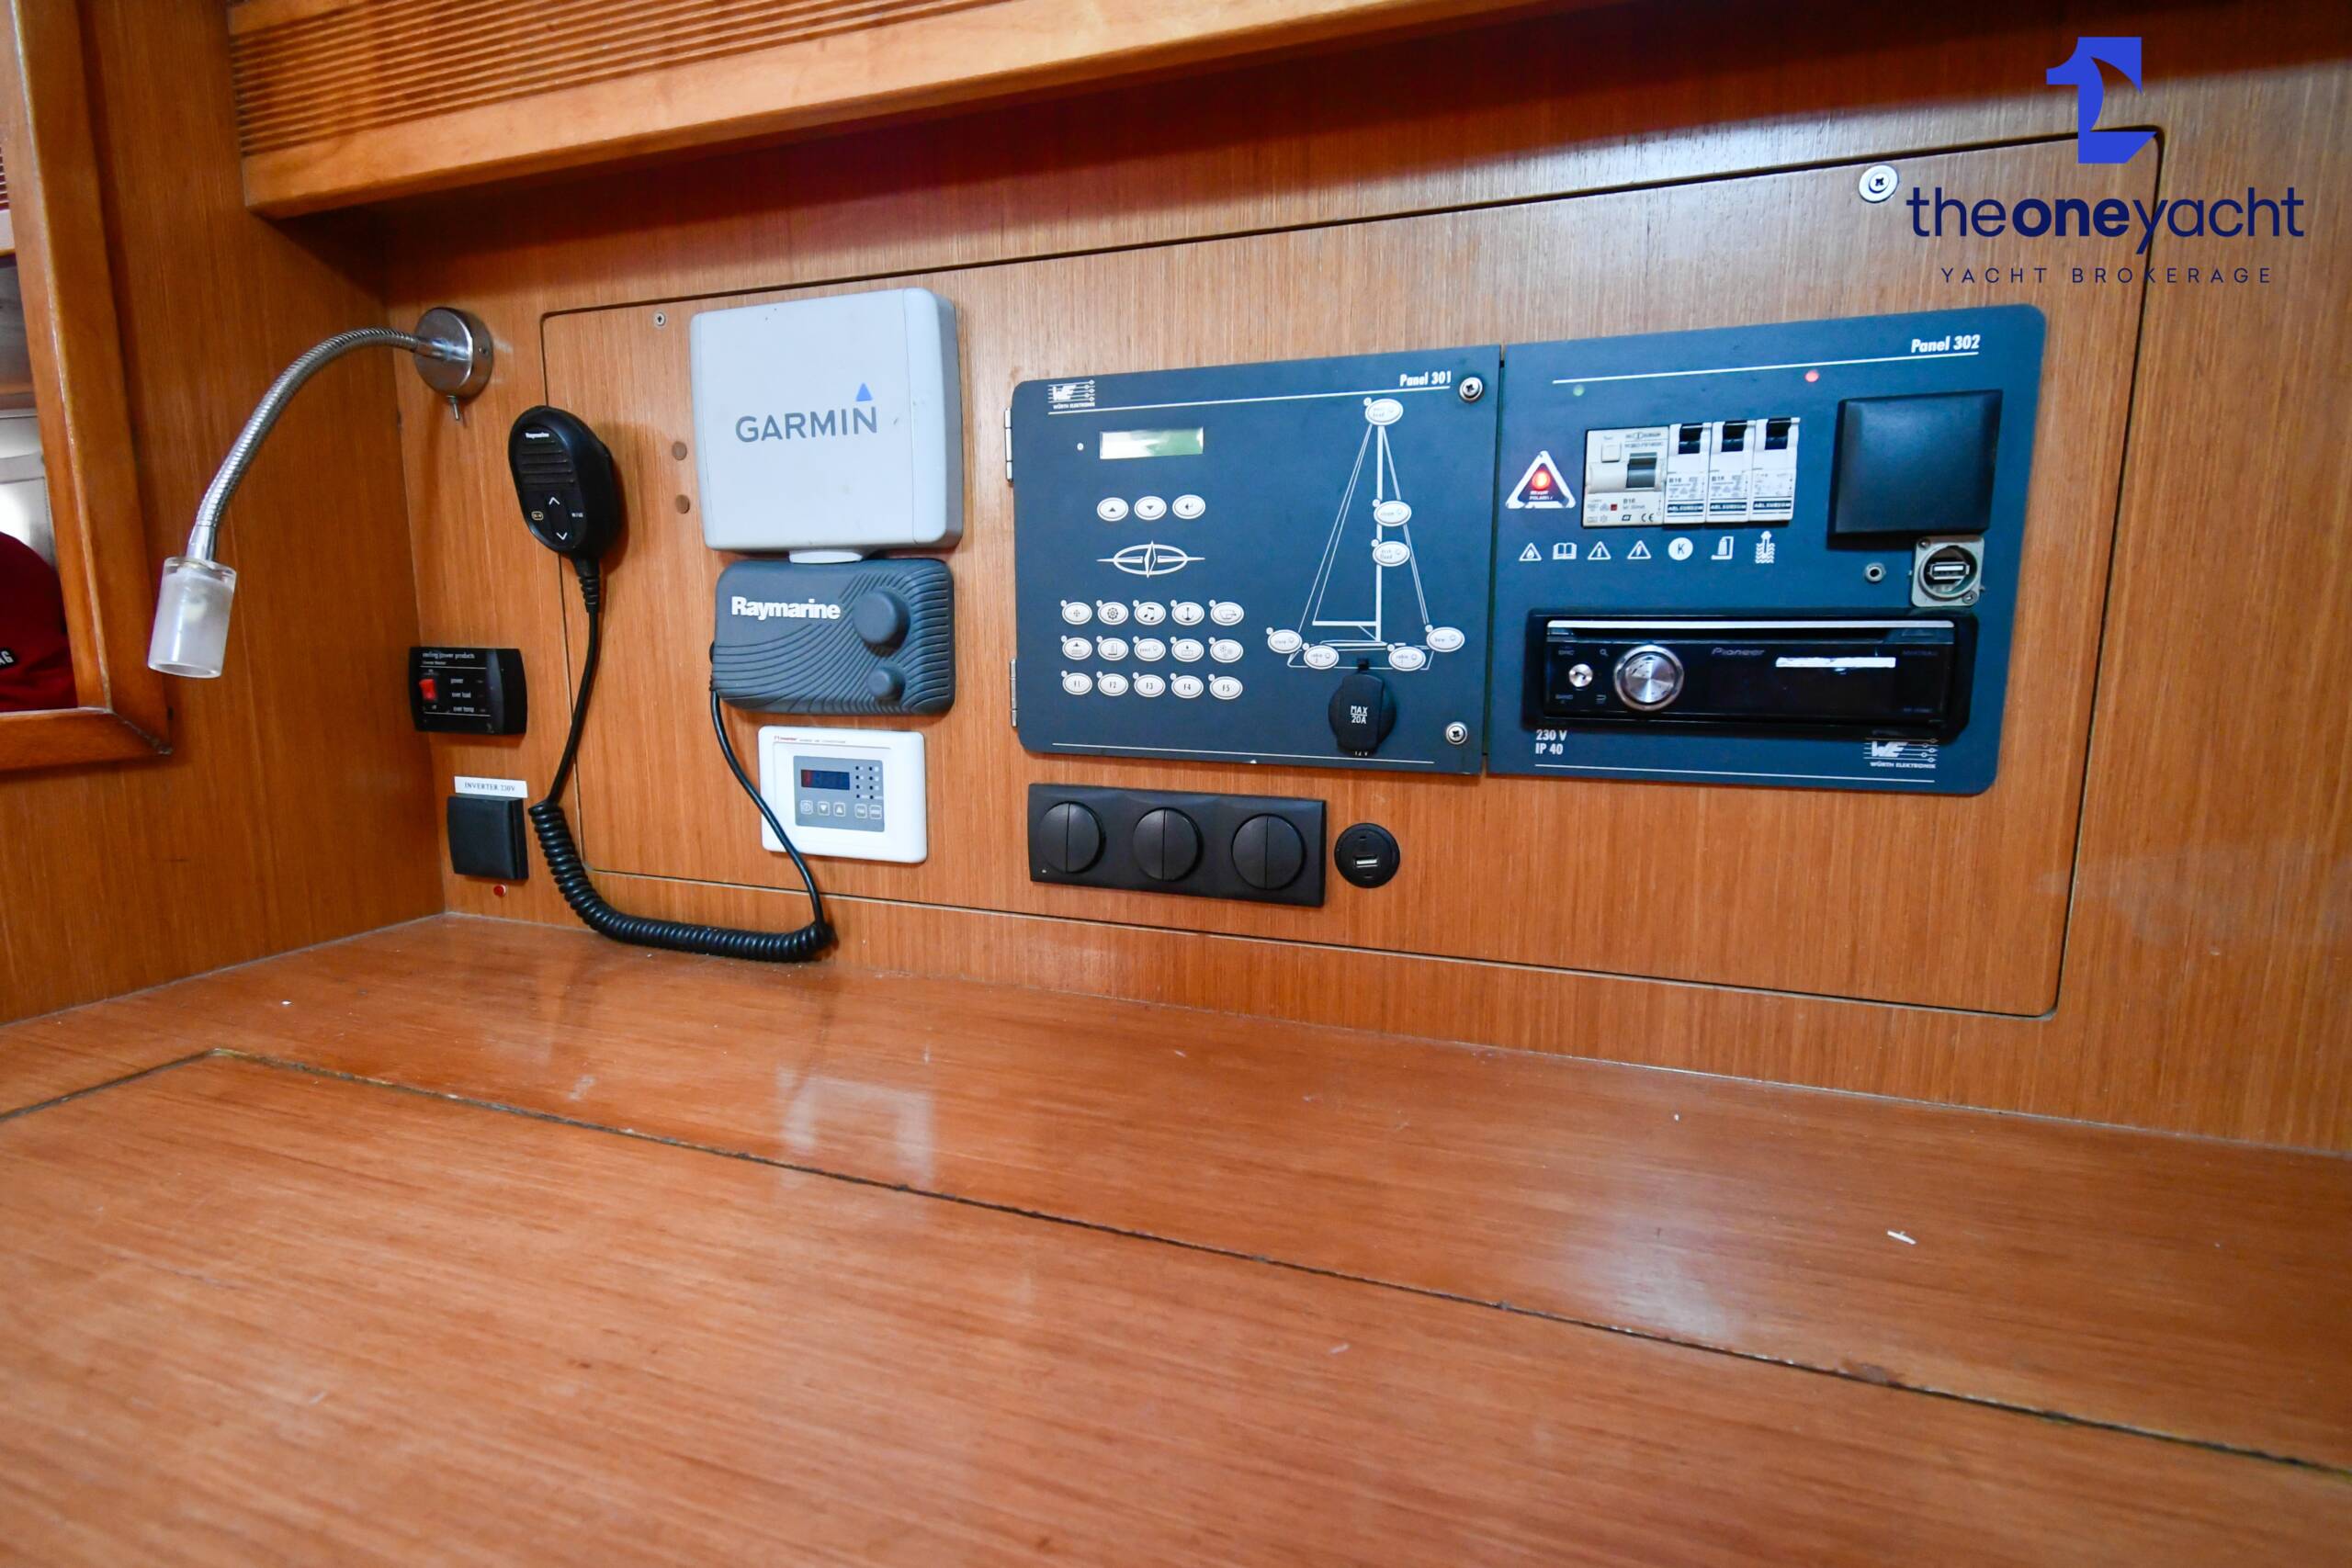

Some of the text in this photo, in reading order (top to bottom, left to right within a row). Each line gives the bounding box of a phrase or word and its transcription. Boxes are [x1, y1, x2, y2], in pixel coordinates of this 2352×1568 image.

[1911, 333, 1981, 354] Panel 302
[1399, 370, 1452, 387] Panel 301
[735, 406, 877, 443] GARMIN
[1677, 543, 1686, 555] K
[731, 596, 841, 621] Raymarine
[1712, 647, 1766, 656] Pioneer
[1351, 705, 1368, 715] MAX
[1351, 716, 1367, 724] 20A
[1535, 728, 1567, 741] 230 V
[1535, 742, 1564, 755] IP 40
[464, 782, 498, 791] INVERTER
